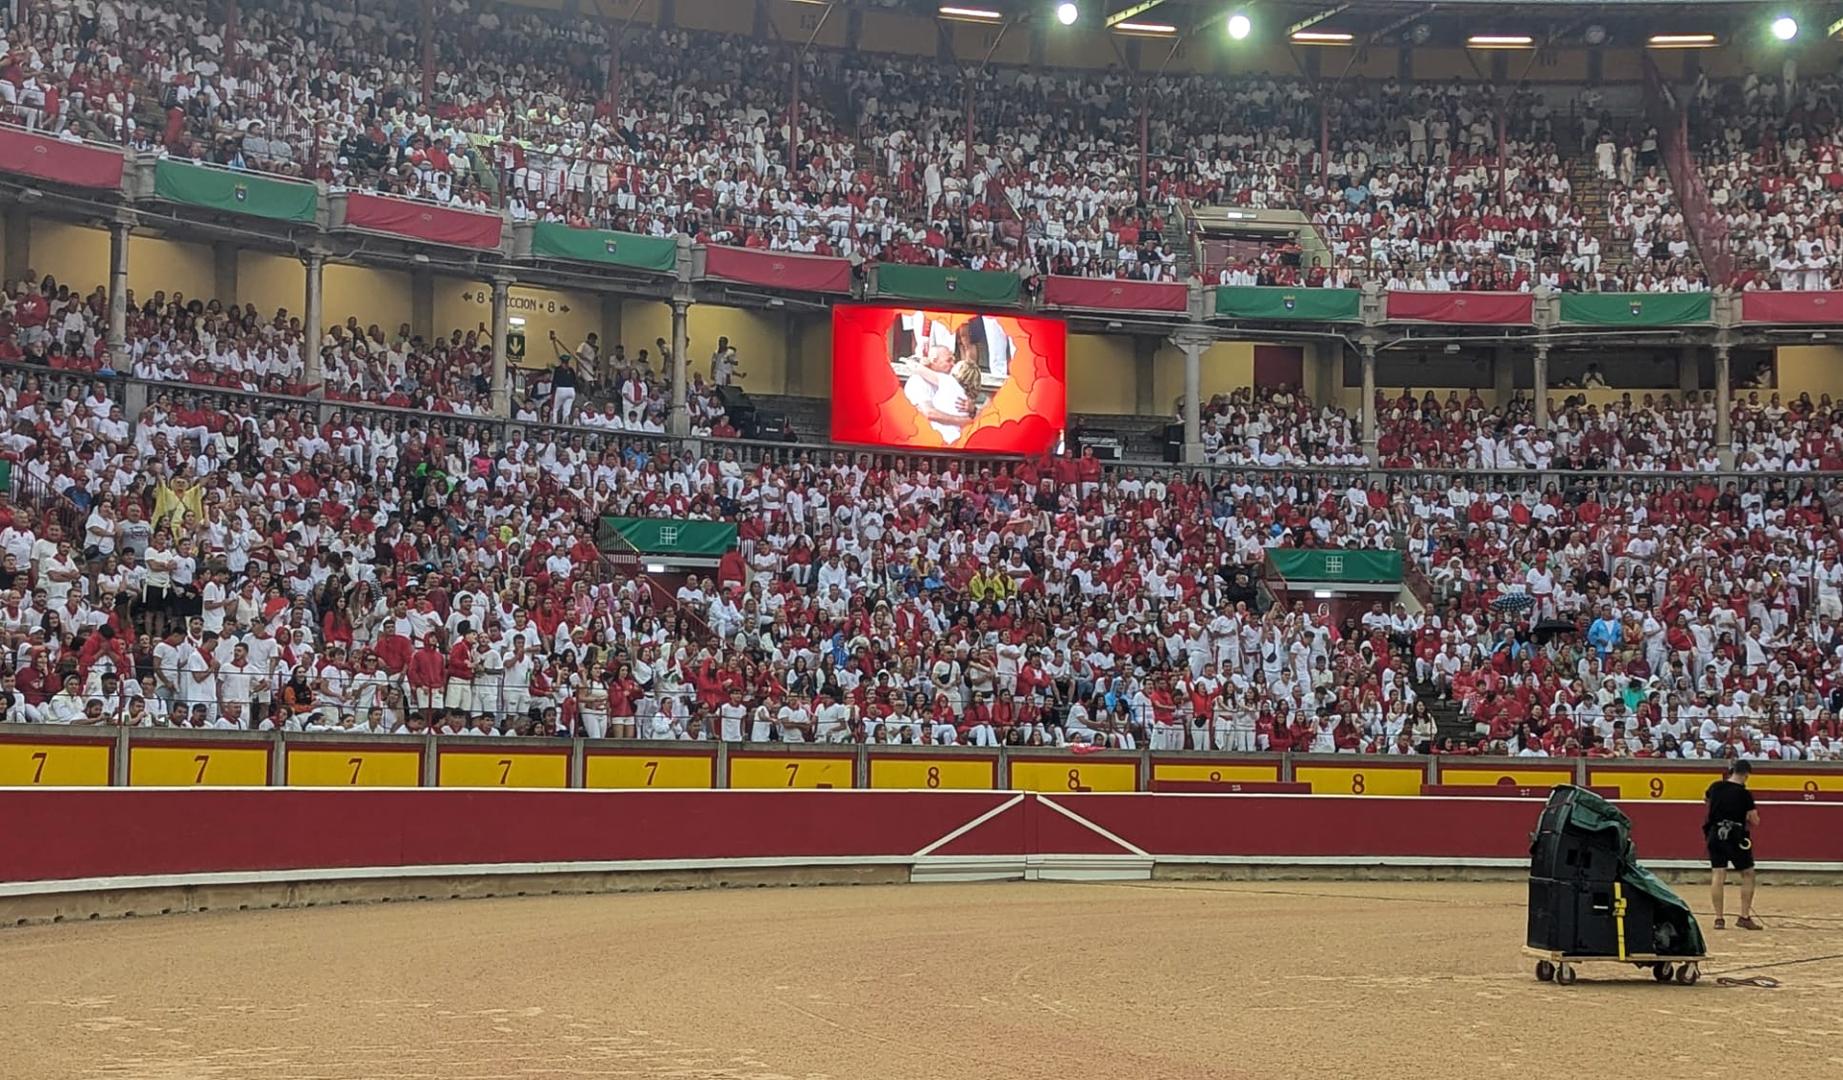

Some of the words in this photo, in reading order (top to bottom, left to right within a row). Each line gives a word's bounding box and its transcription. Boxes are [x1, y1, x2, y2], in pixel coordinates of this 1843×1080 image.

[476, 291, 485, 304] 8
[506, 297, 536, 311] CCION
[547, 301, 556, 313] 8
[31, 753, 47, 783] 7
[194, 755, 209, 783] 7
[348, 758, 362, 784] 7
[498, 760, 512, 785] 7
[644, 762, 658, 785] 7
[786, 764, 799, 786] 7
[927, 767, 939, 788] 8
[1068, 769, 1080, 790] 8
[1352, 774, 1364, 794] 8
[1650, 778, 1664, 798] 9
